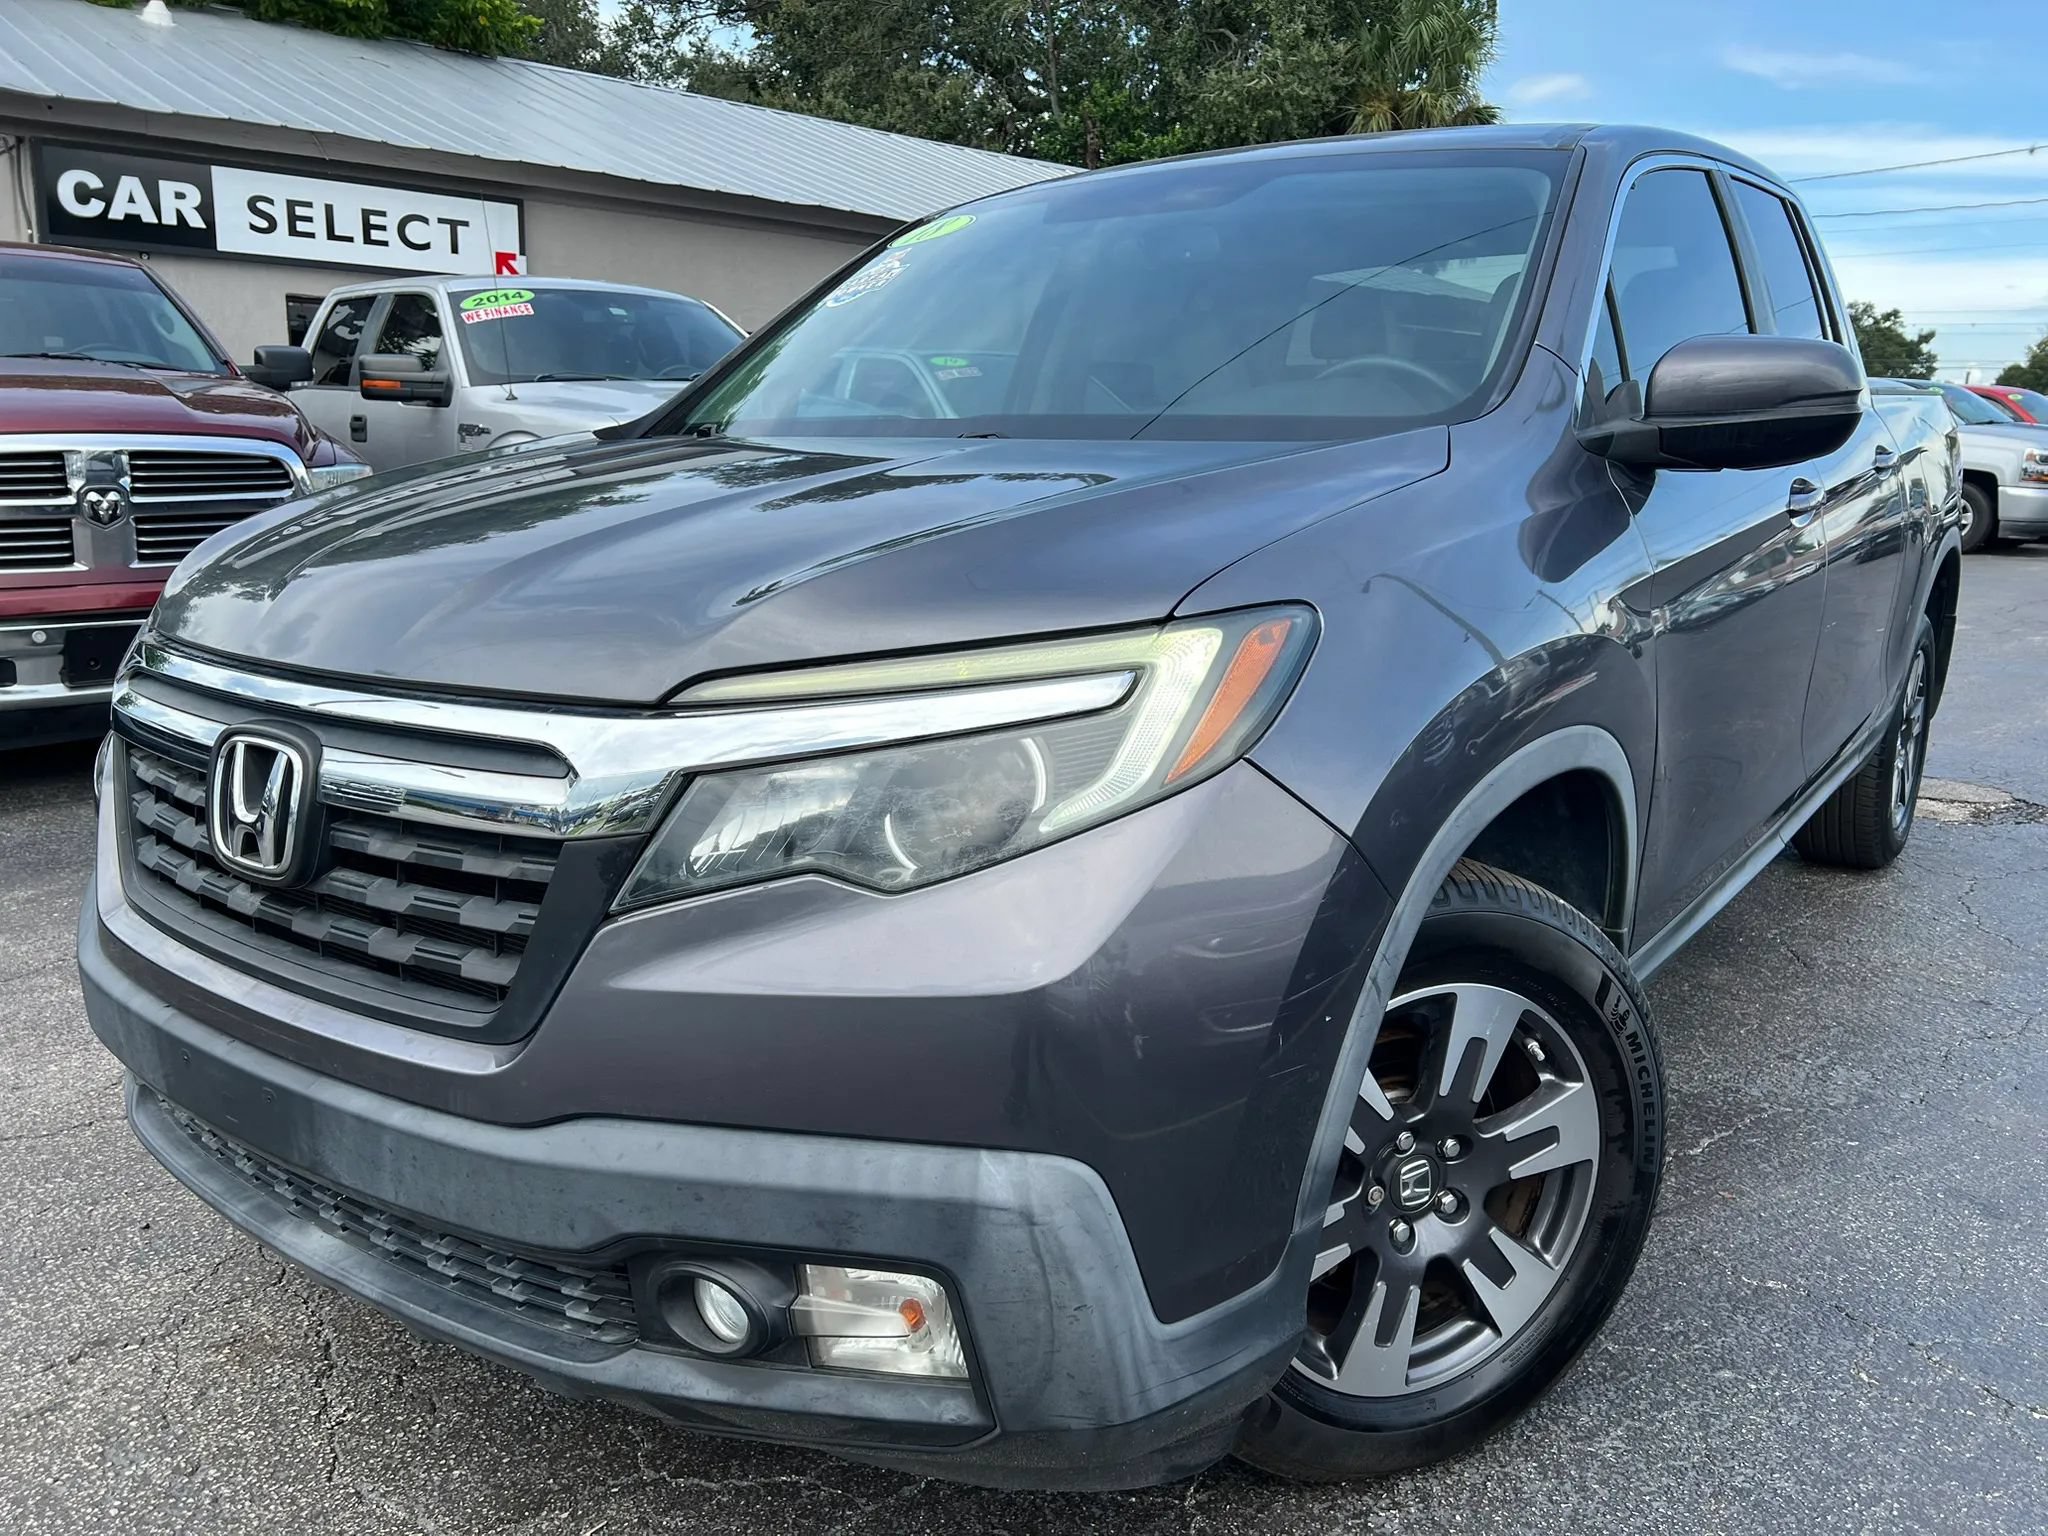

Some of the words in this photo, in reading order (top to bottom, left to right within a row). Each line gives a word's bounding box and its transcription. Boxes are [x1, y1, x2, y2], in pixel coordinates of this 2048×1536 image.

[57, 169, 207, 229] CAR
[246, 194, 470, 255] SELECT
[464, 310, 483, 322] WE
[484, 304, 532, 319] FINANCE
[472, 291, 525, 307] 2014
[1625, 1031, 1655, 1167] MICHELIN
